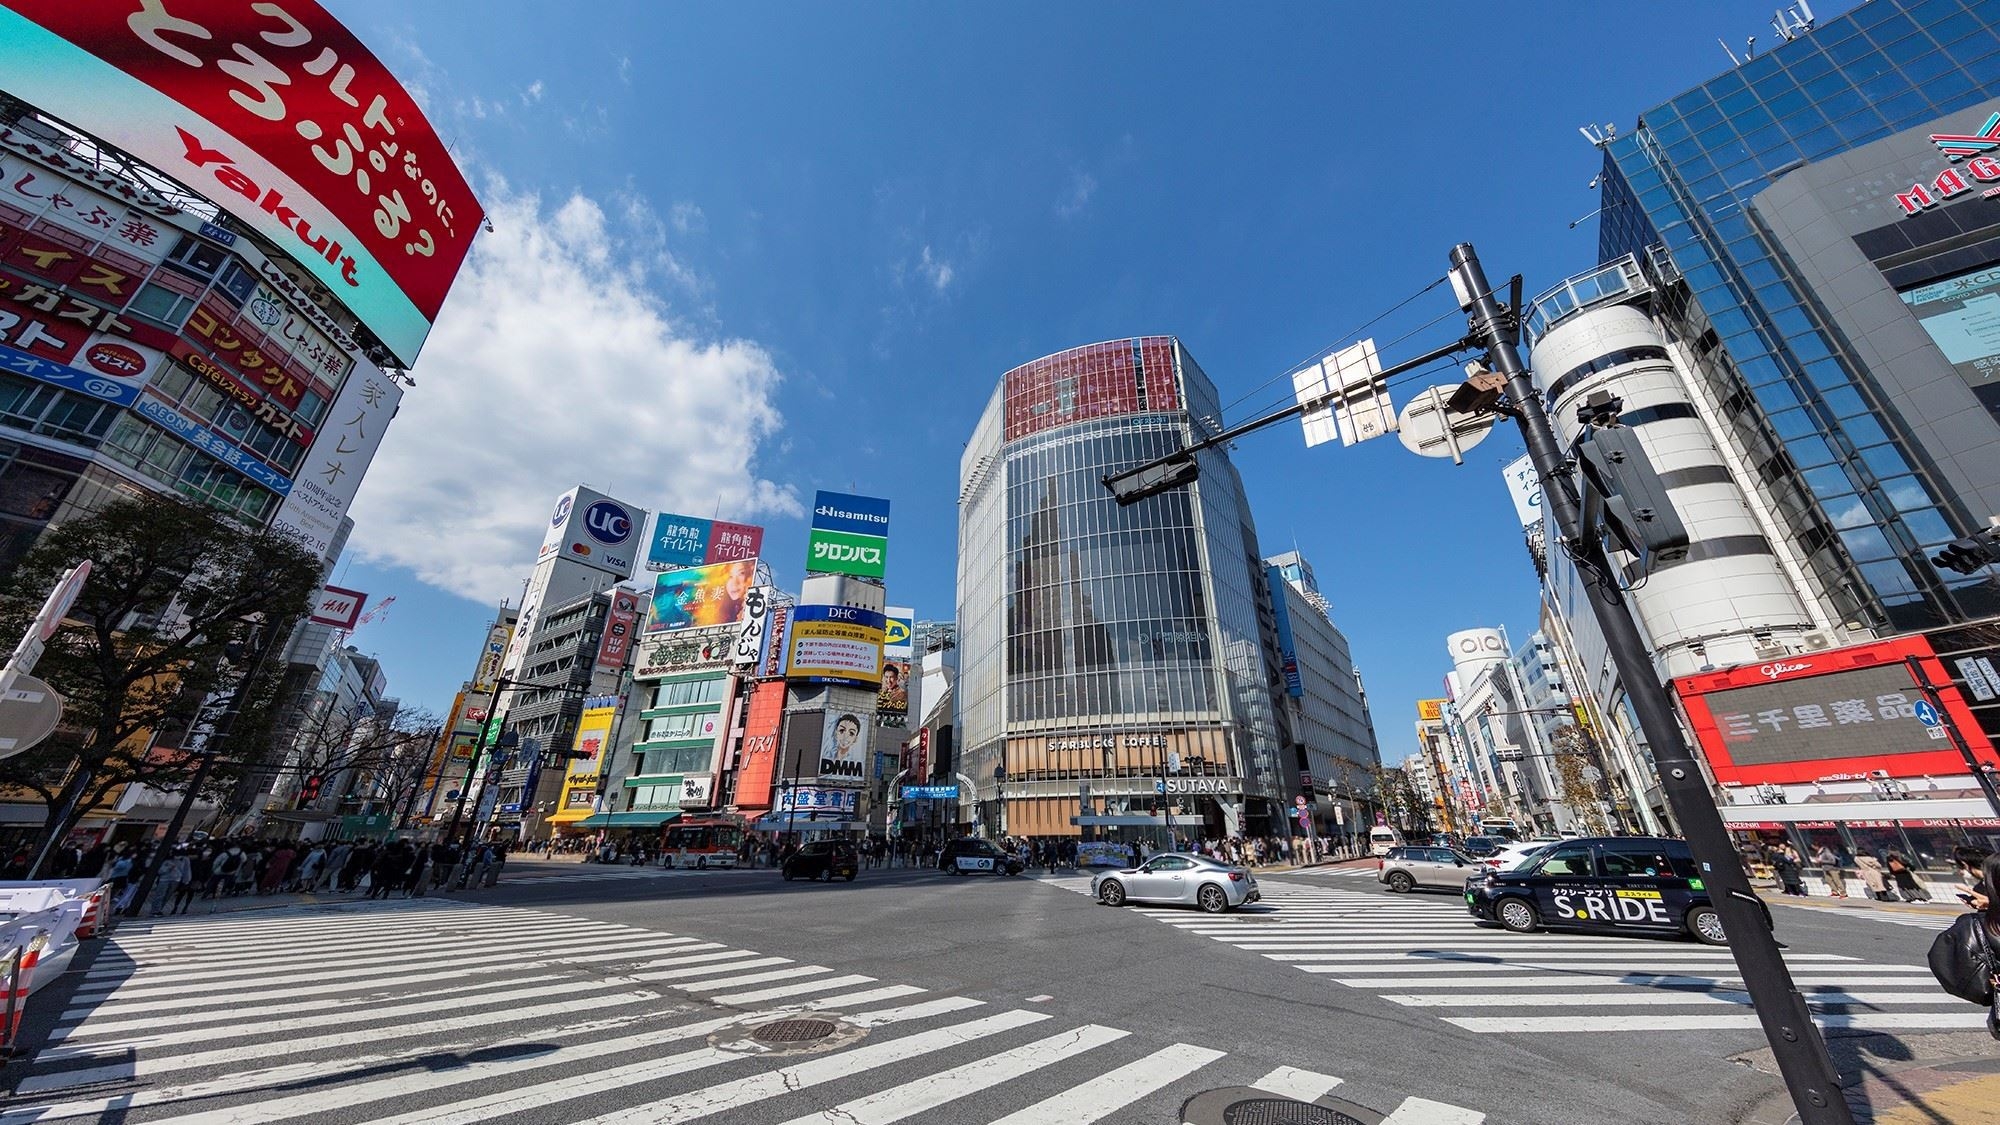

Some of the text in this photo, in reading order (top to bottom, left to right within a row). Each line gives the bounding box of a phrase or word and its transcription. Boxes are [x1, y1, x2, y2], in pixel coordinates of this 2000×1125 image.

[14, 172, 159, 247] しゃぶ葉
[174, 125, 359, 287] Yakult
[260, 259, 358, 352] しゃぶしゃぶバイキング
[188, 307, 299, 398] コンタクト
[283, 317, 344, 377] しゃぶ葉
[92, 353, 138, 371] ガスト
[87, 379, 120, 398] 6F
[144, 402, 188, 431] AEON
[255, 400, 304, 439] ガスト
[320, 376, 387, 486] 家入レオ
[192, 426, 290, 491] 英会話イーオン
[589, 507, 630, 537] UC
[815, 505, 888, 524] Hisamitsu
[660, 537, 703, 552] ダイレクト
[813, 541, 881, 565] サロンパス
[606, 556, 627, 569] VISA
[737, 586, 766, 660] もんじゃ
[828, 607, 858, 620] DHC
[1760, 662, 1812, 679] Glico
[1724, 693, 1917, 736] 三千里薬品
[1048, 738, 1115, 751] STARBUCKS
[820, 759, 863, 777] DMM
[1551, 887, 1614, 897] タクシーアプリ
